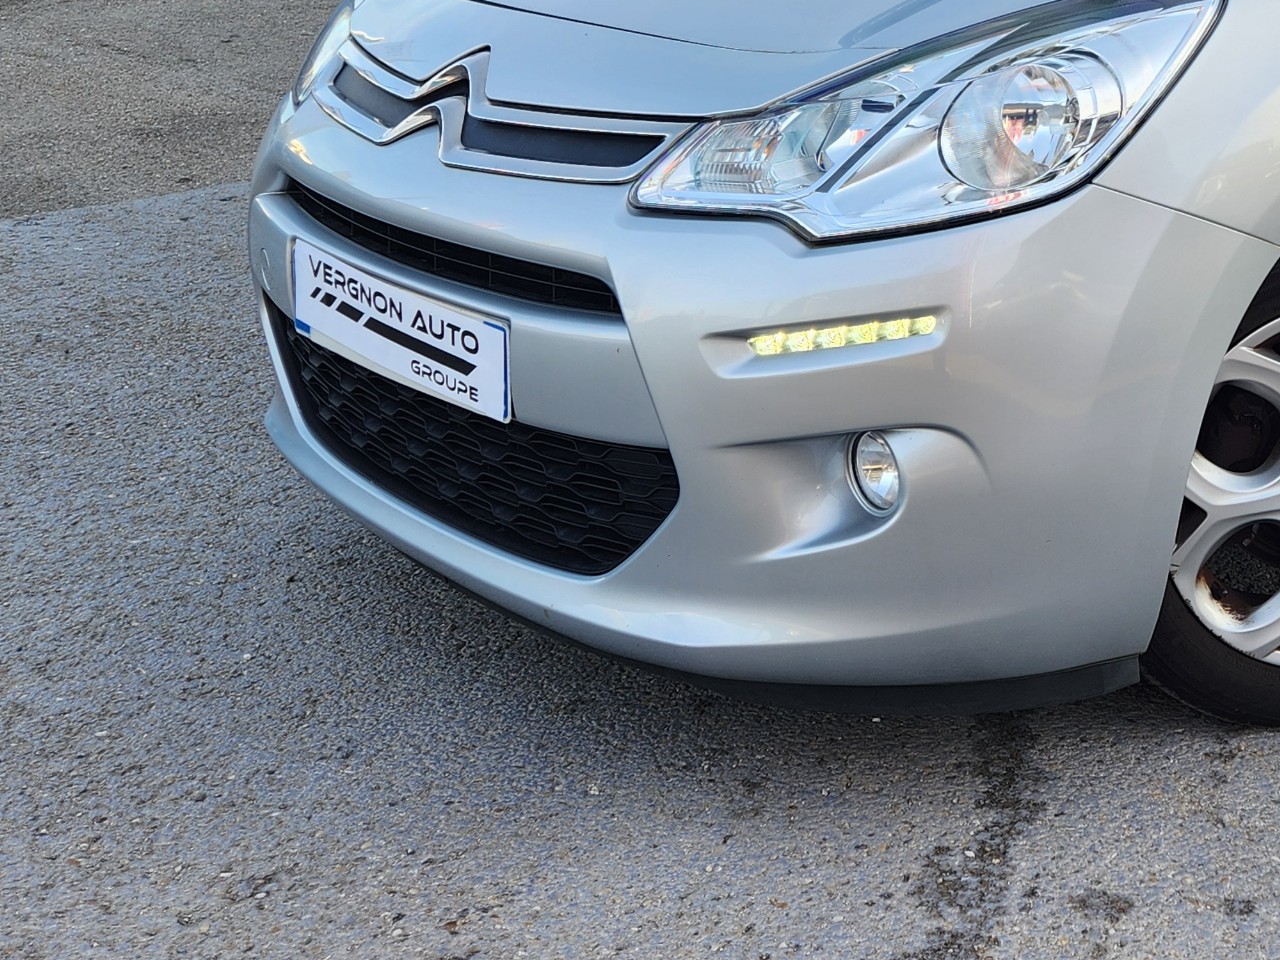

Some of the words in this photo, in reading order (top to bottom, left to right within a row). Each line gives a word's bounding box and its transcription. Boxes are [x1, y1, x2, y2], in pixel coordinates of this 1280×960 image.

[308, 254, 404, 324] VERGNON
[410, 309, 480, 355] AUTO
[410, 359, 480, 403] GROUPE
